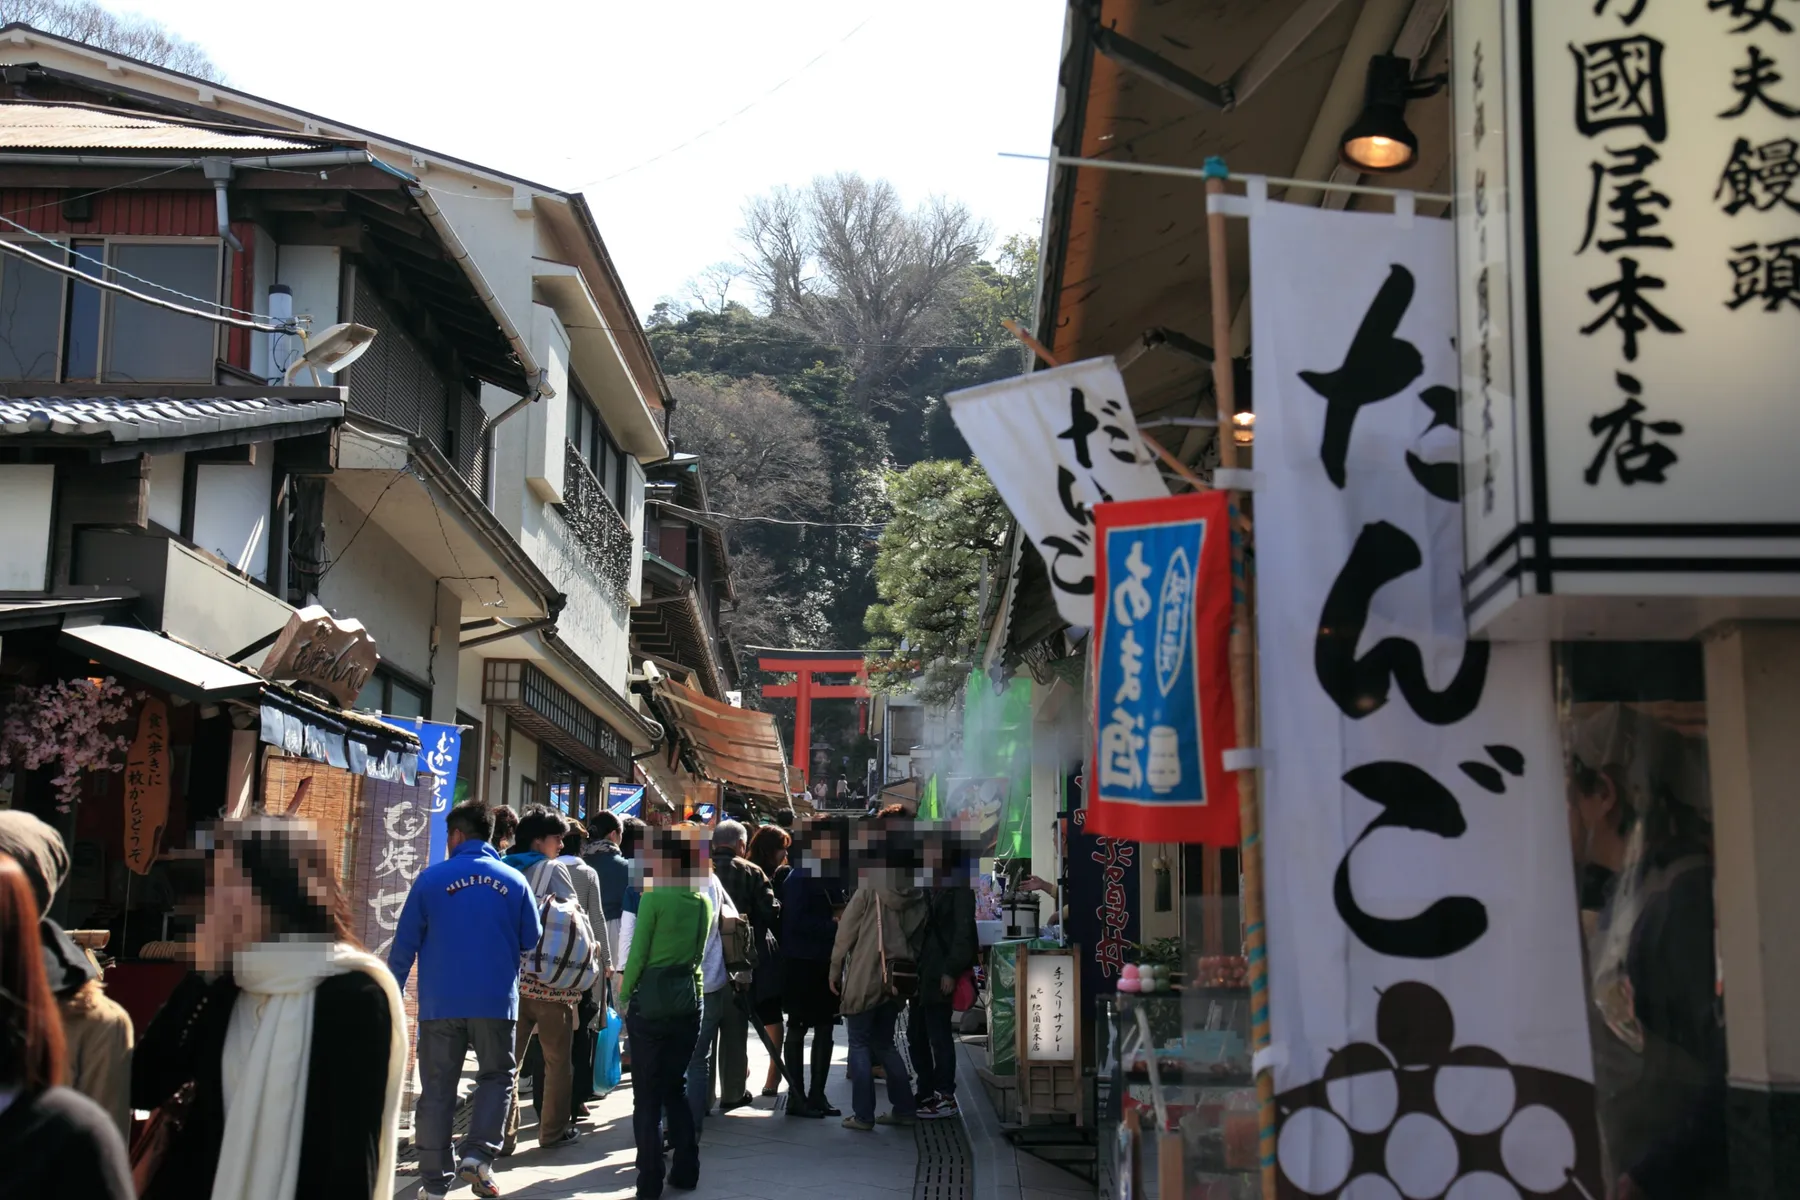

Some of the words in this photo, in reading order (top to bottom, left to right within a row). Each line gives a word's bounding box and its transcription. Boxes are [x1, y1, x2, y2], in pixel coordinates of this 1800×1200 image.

[1296, 262, 1525, 958] だんご
[128, 760, 145, 864] 一枚からどうぞ
[368, 801, 428, 955] もち焼せ
[446, 875, 509, 897] HILFIGER
[529, 986, 544, 995] cher
[549, 988, 562, 997] cher
[1053, 966, 1064, 1052] 手づくりサブレー
